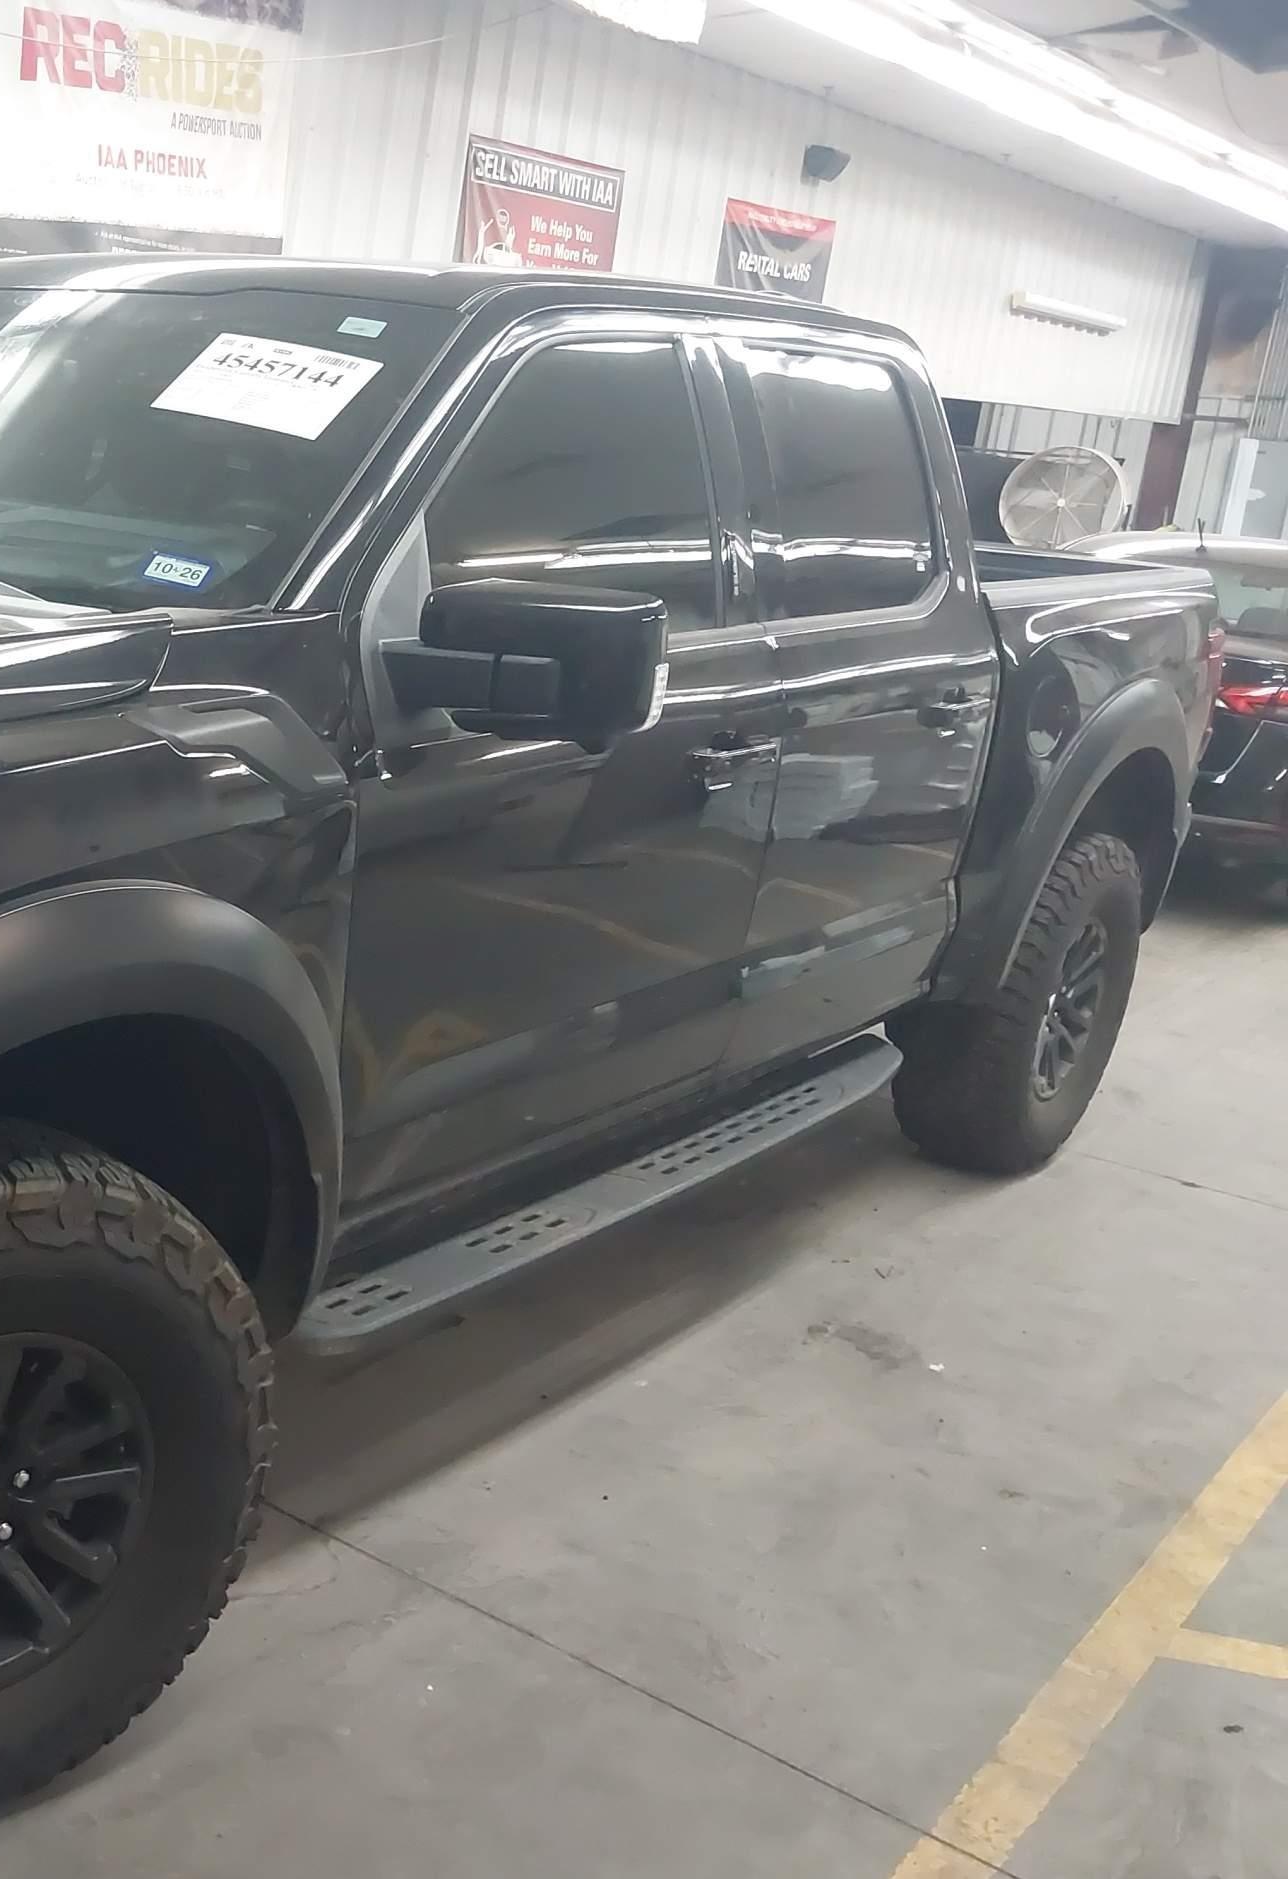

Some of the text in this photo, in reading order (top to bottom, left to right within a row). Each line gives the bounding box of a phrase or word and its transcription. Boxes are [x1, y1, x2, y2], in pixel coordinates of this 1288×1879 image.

[137, 30, 265, 113] RIDES
[170, 111, 262, 141] A POWERSPORT AUCTION
[97, 143, 208, 180] IAA PHOENIX
[475, 150, 613, 206] SELL SMART WITH IAA
[530, 215, 593, 243] We Help You
[527, 238, 552, 257] Earn
[553, 243, 580, 263] More
[581, 248, 599, 266] For
[737, 250, 812, 282] RENTAL CARS
[212, 352, 345, 388] 45457144
[153, 561, 203, 581] 10 26
